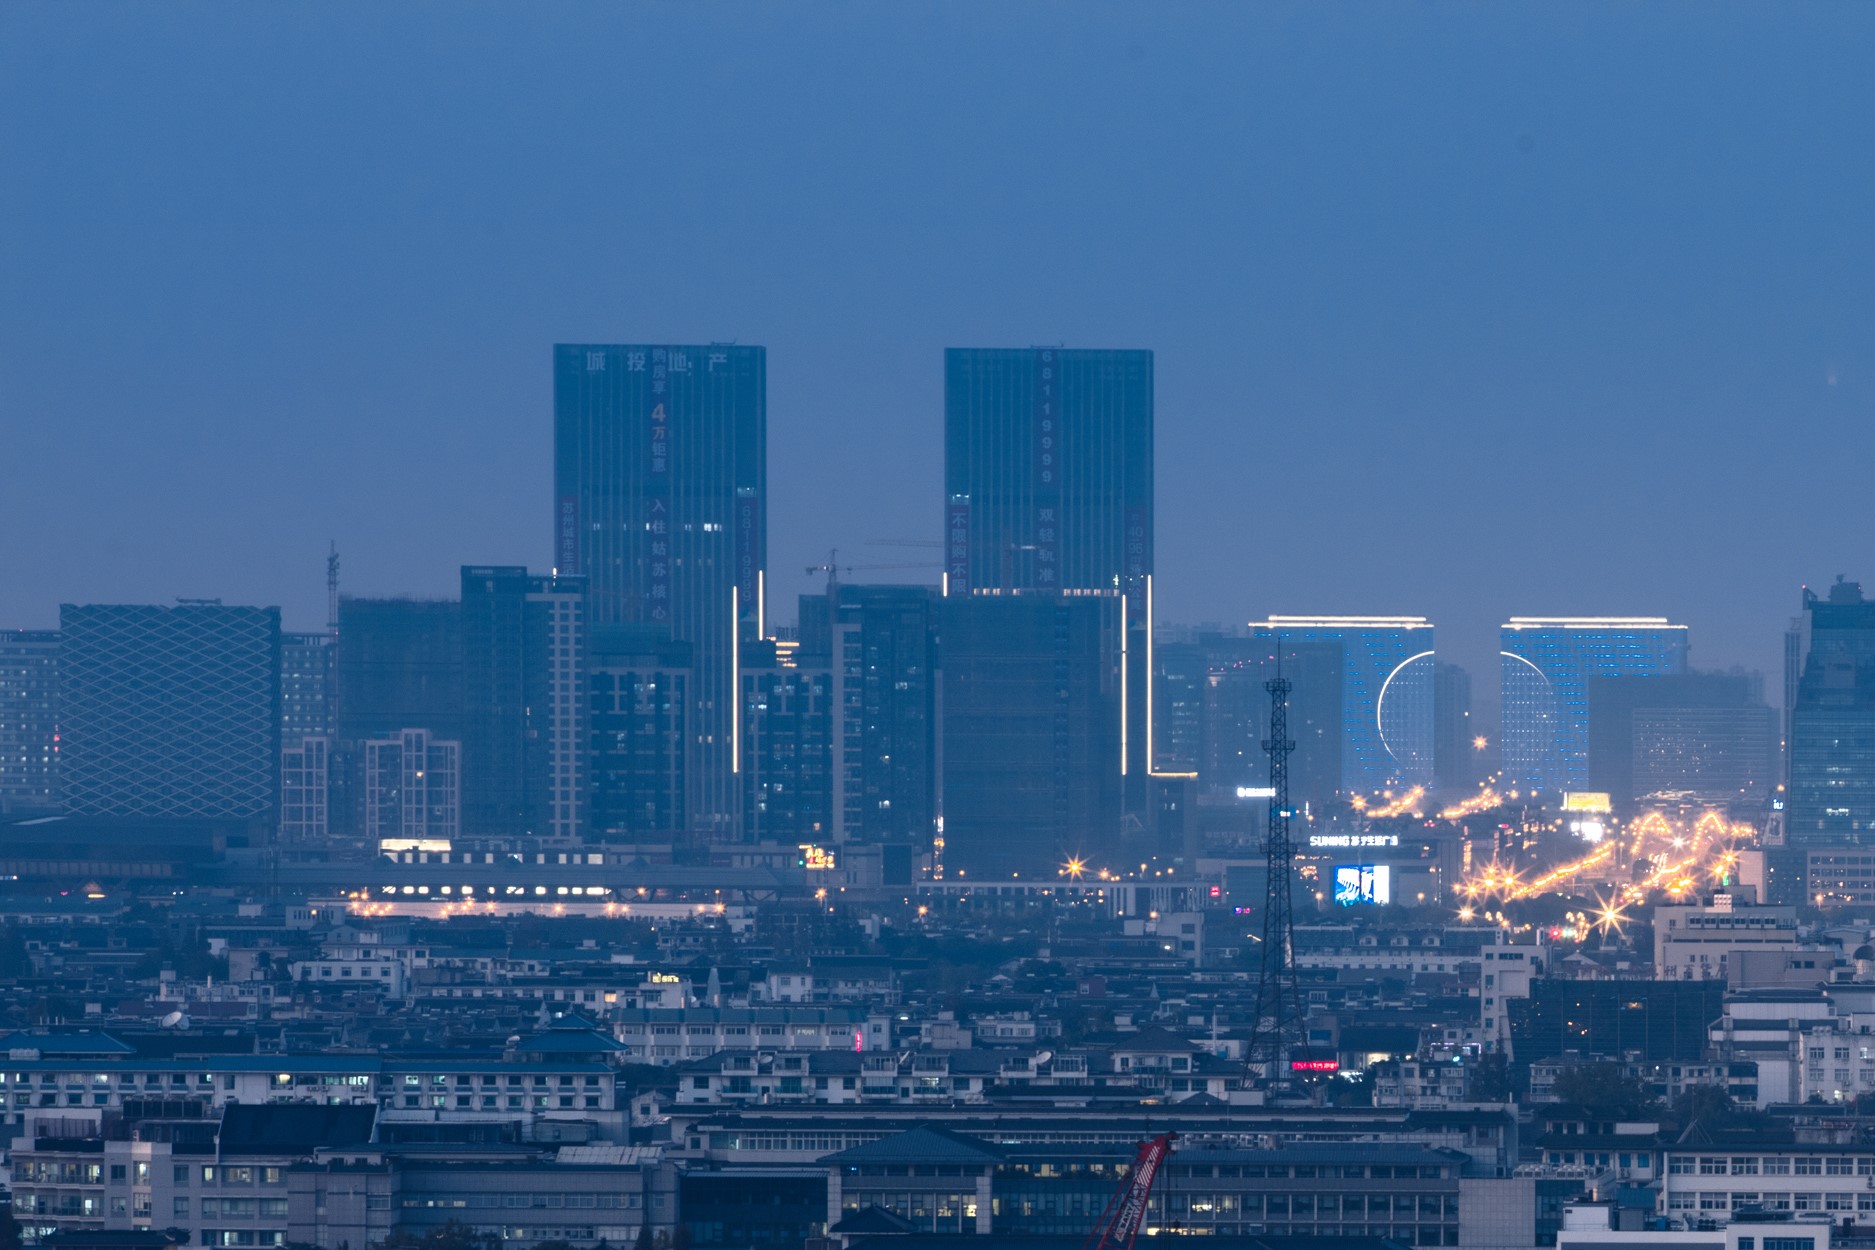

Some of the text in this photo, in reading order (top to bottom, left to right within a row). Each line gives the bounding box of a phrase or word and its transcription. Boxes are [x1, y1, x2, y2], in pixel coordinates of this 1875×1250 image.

[586, 351, 728, 372] 城投地产
[1042, 351, 1053, 484] 68119999
[652, 500, 667, 620] 入住姑苏核心
[952, 513, 967, 594] 不限购不限
[1309, 835, 1350, 847] SUNING
